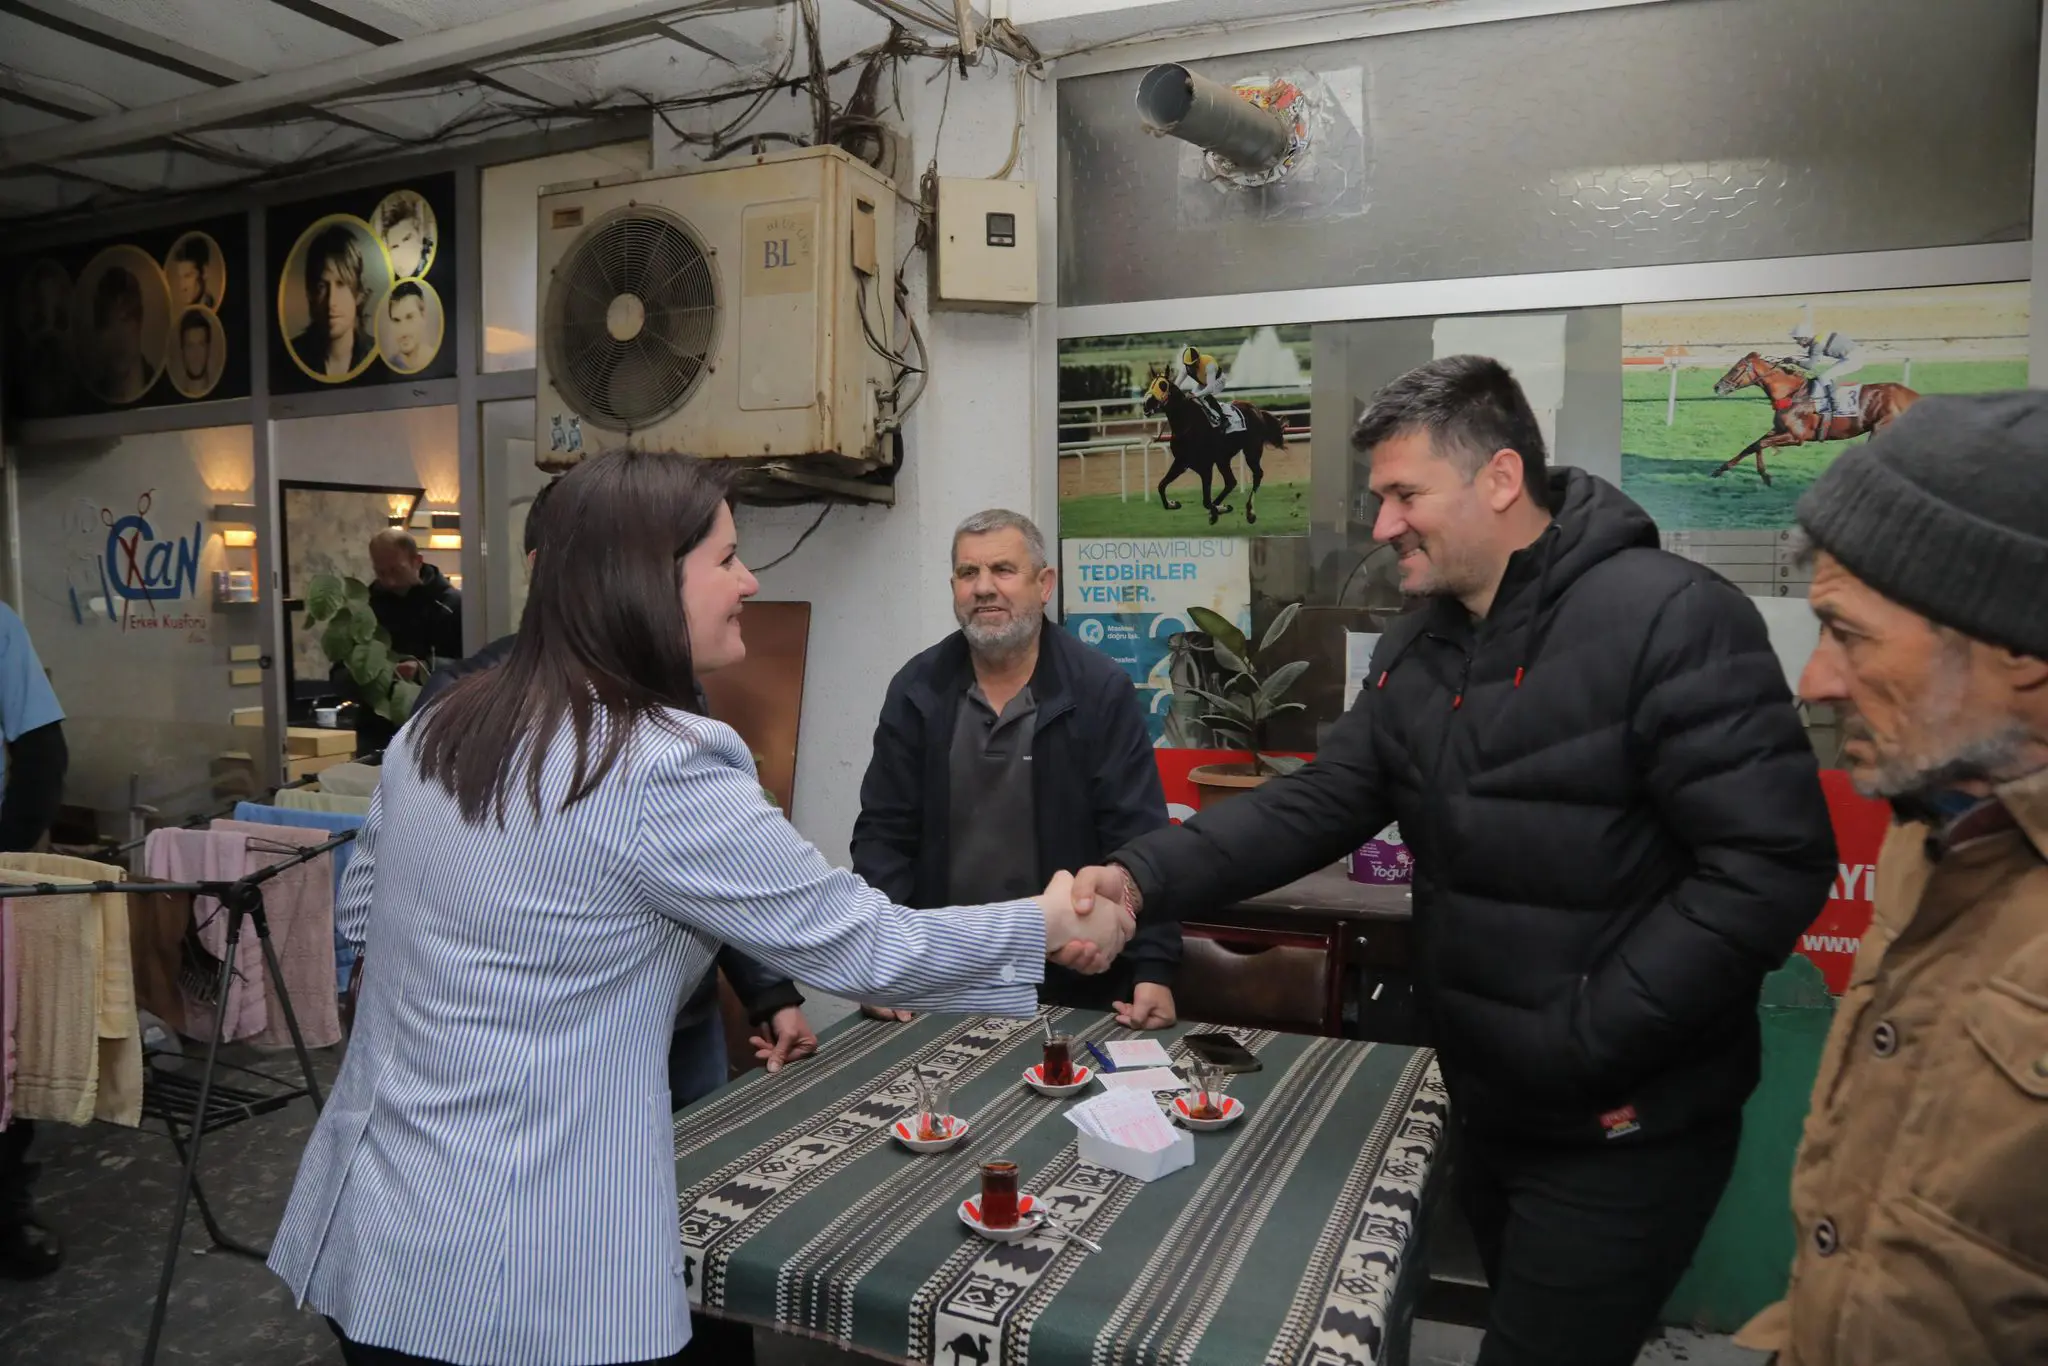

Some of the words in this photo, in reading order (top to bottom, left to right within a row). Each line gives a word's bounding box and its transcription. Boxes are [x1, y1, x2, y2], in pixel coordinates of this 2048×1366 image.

[764, 239, 797, 268] BL
[1848, 390, 1857, 408] 3
[1079, 560, 1197, 581] TEDBİRLER
[1781, 565, 1789, 578] 8
[1079, 585, 1156, 602] YENER.
[1780, 584, 1789, 597] 9
